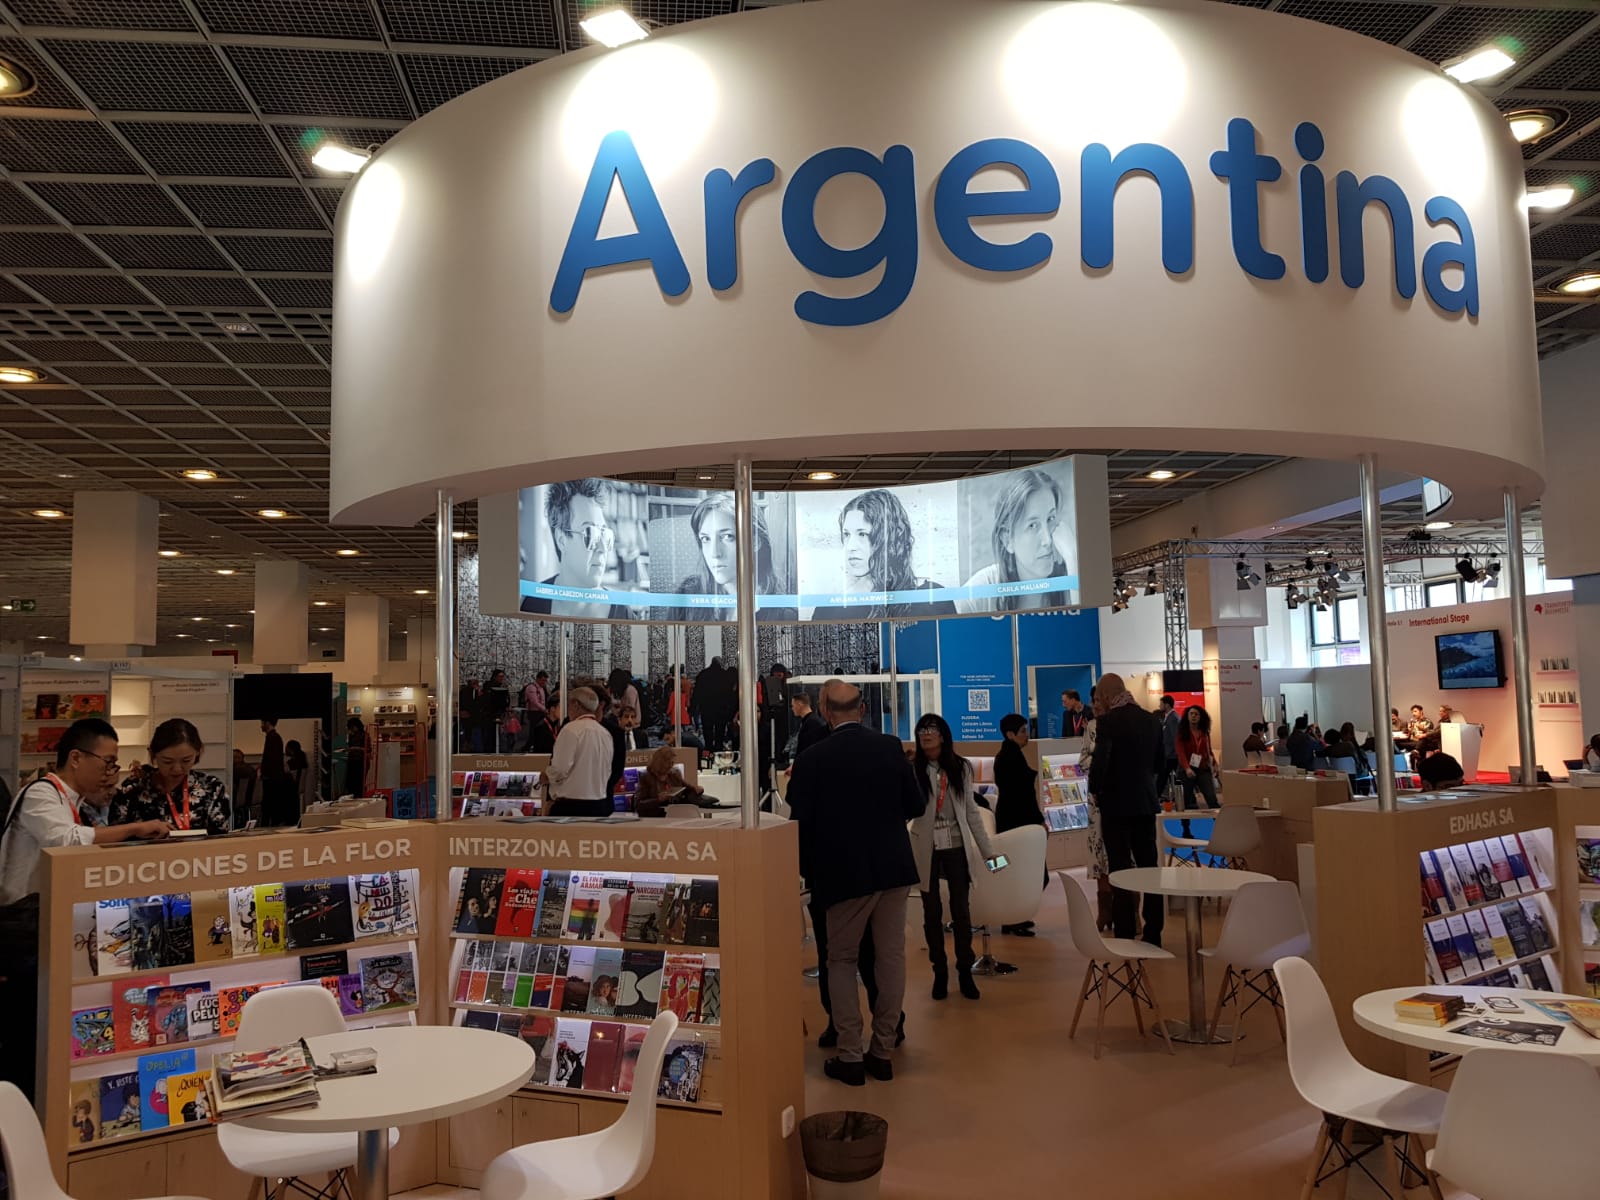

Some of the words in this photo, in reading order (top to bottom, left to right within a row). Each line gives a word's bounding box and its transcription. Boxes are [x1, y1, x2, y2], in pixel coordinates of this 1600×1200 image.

[548, 118, 1479, 326] Argentina
[997, 585, 1019, 593] CARLA
[1408, 615, 1450, 627] International
[1450, 614, 1470, 624] Stage
[475, 759, 509, 769] EUDEBA
[1449, 810, 1497, 834] EDHASA
[1499, 807, 1515, 825] SA
[449, 837, 572, 858] INTERZONA
[578, 839, 680, 861] EDITORA
[686, 841, 717, 862] SA
[84, 853, 248, 889] EDICIONES
[257, 849, 294, 872] DE
[303, 845, 337, 867] LA
[345, 838, 411, 862] FLOR
[515, 893, 538, 905] Che
[192, 1008, 219, 1022] PELU
